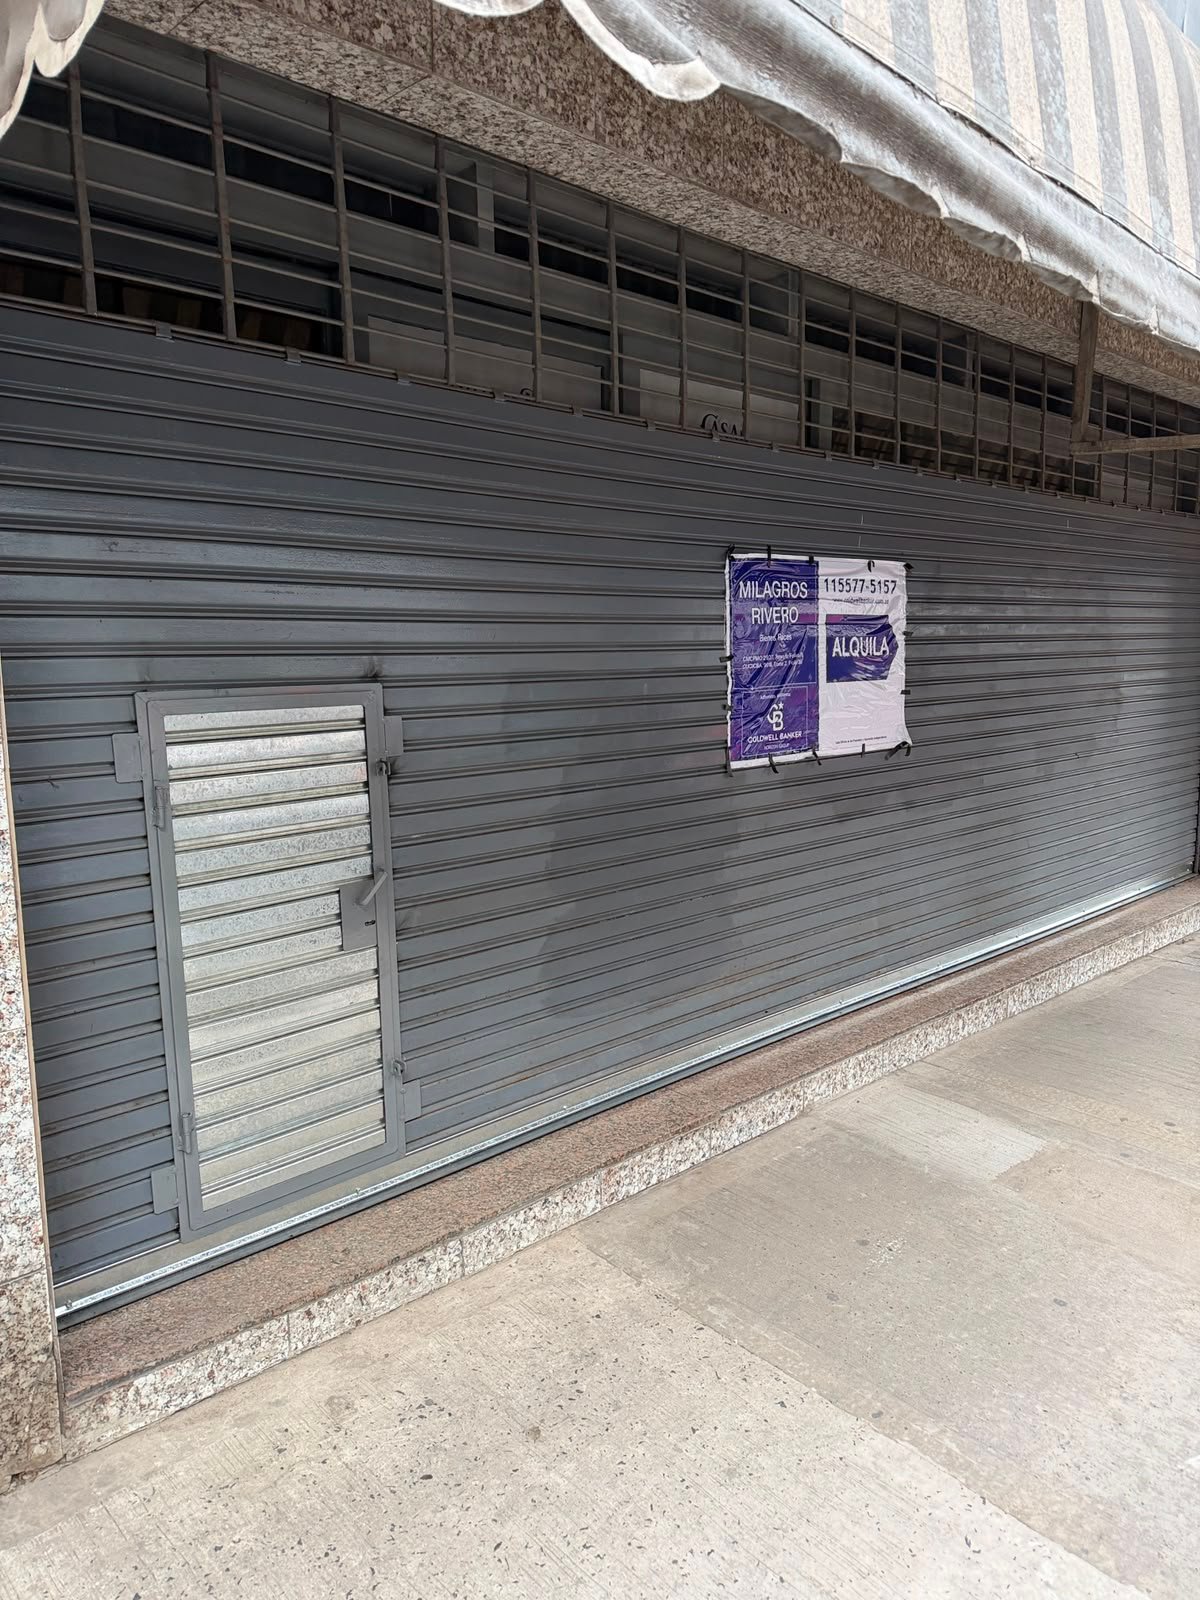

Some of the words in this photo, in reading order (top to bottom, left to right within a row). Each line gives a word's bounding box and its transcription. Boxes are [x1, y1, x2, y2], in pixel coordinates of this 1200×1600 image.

[739, 580, 808, 599] MILAGROS
[824, 577, 897, 595] 115577-5157
[751, 606, 799, 625] RIVERO
[832, 636, 890, 658] ALQUILA
[747, 732, 779, 744] COLDWELL
[779, 730, 803, 740] BANKER
